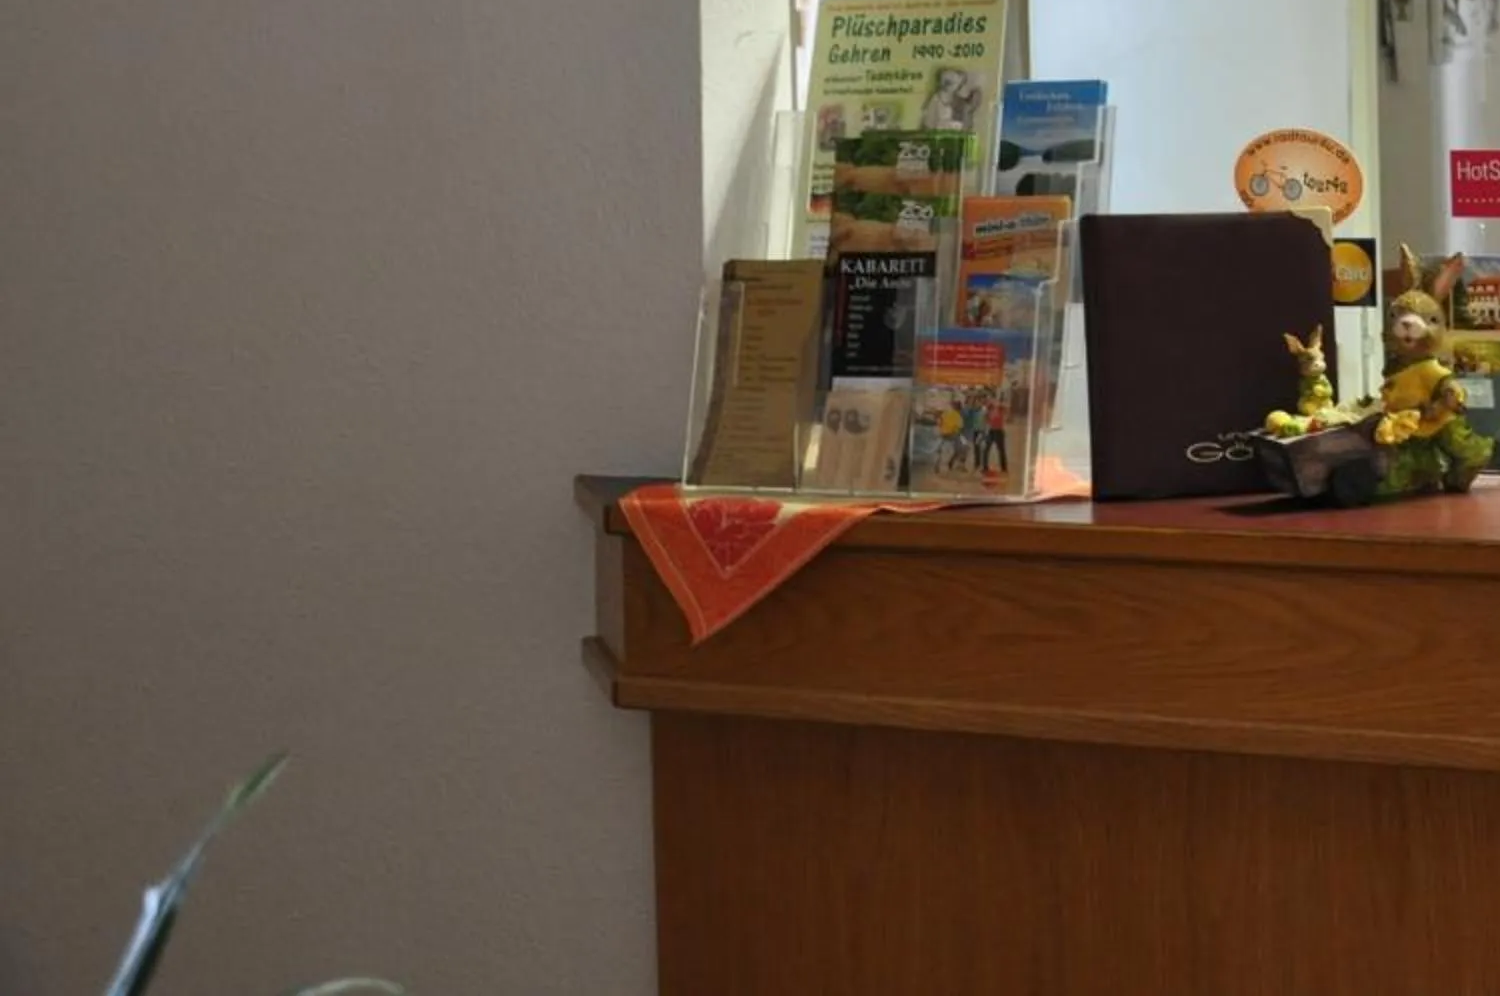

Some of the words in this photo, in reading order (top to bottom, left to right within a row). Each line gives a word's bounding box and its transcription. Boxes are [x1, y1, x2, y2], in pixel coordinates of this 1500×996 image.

[831, 12, 987, 43] Plüschparadies
[828, 43, 892, 64] Gehren
[898, 140, 931, 159] Zoo
[841, 258, 927, 274] KABARETT
